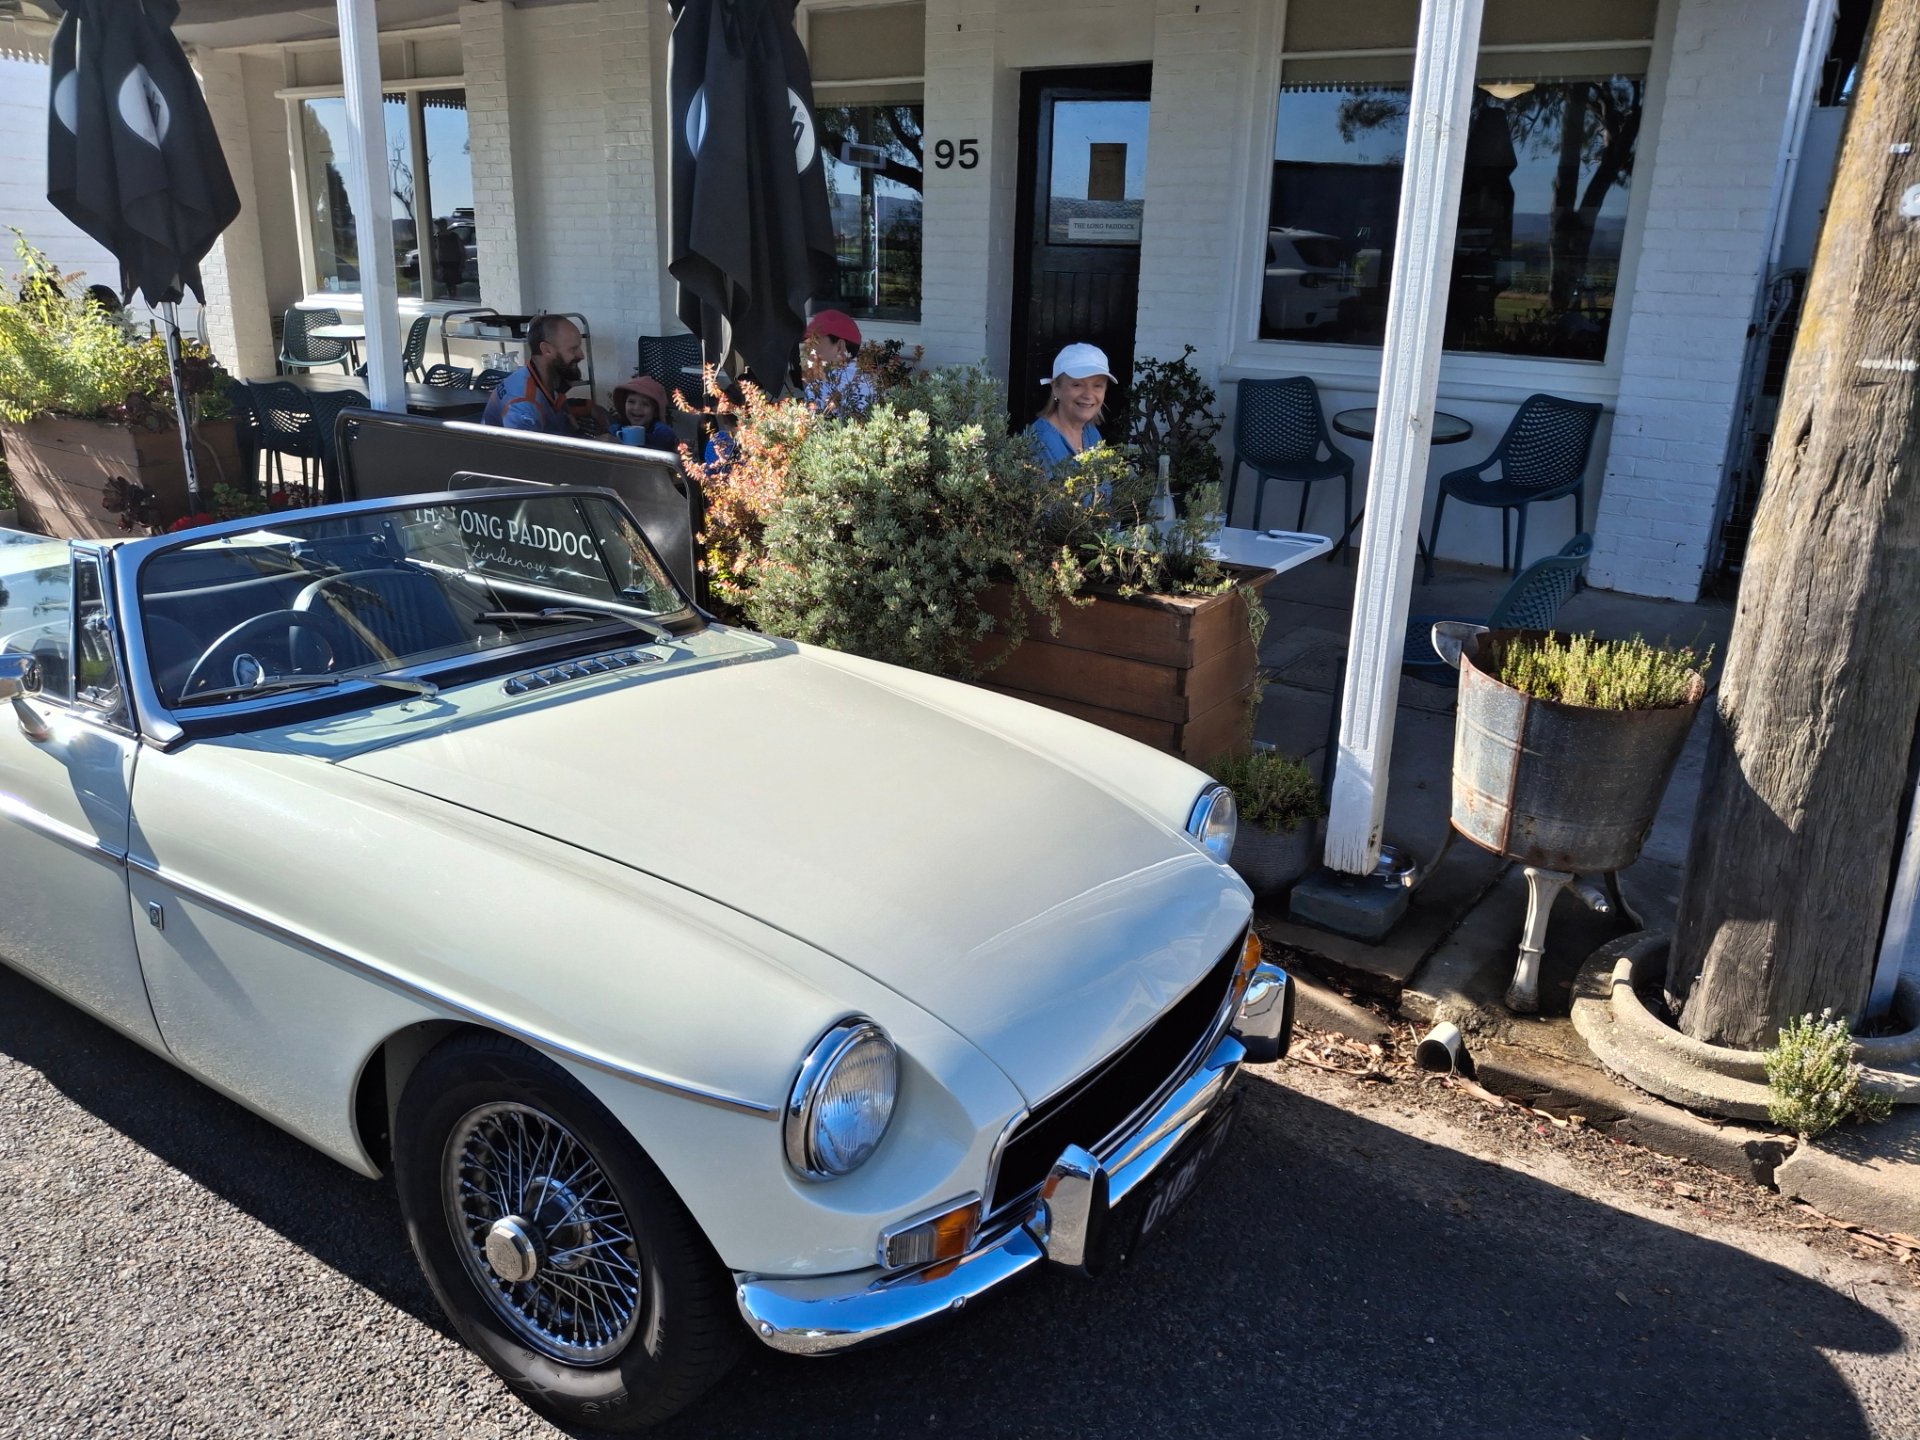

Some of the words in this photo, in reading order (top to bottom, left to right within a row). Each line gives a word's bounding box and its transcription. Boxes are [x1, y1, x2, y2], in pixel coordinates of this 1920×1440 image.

[934, 138, 979, 170] 95
[415, 506, 448, 523] TH
[471, 540, 546, 573] Lindenow
